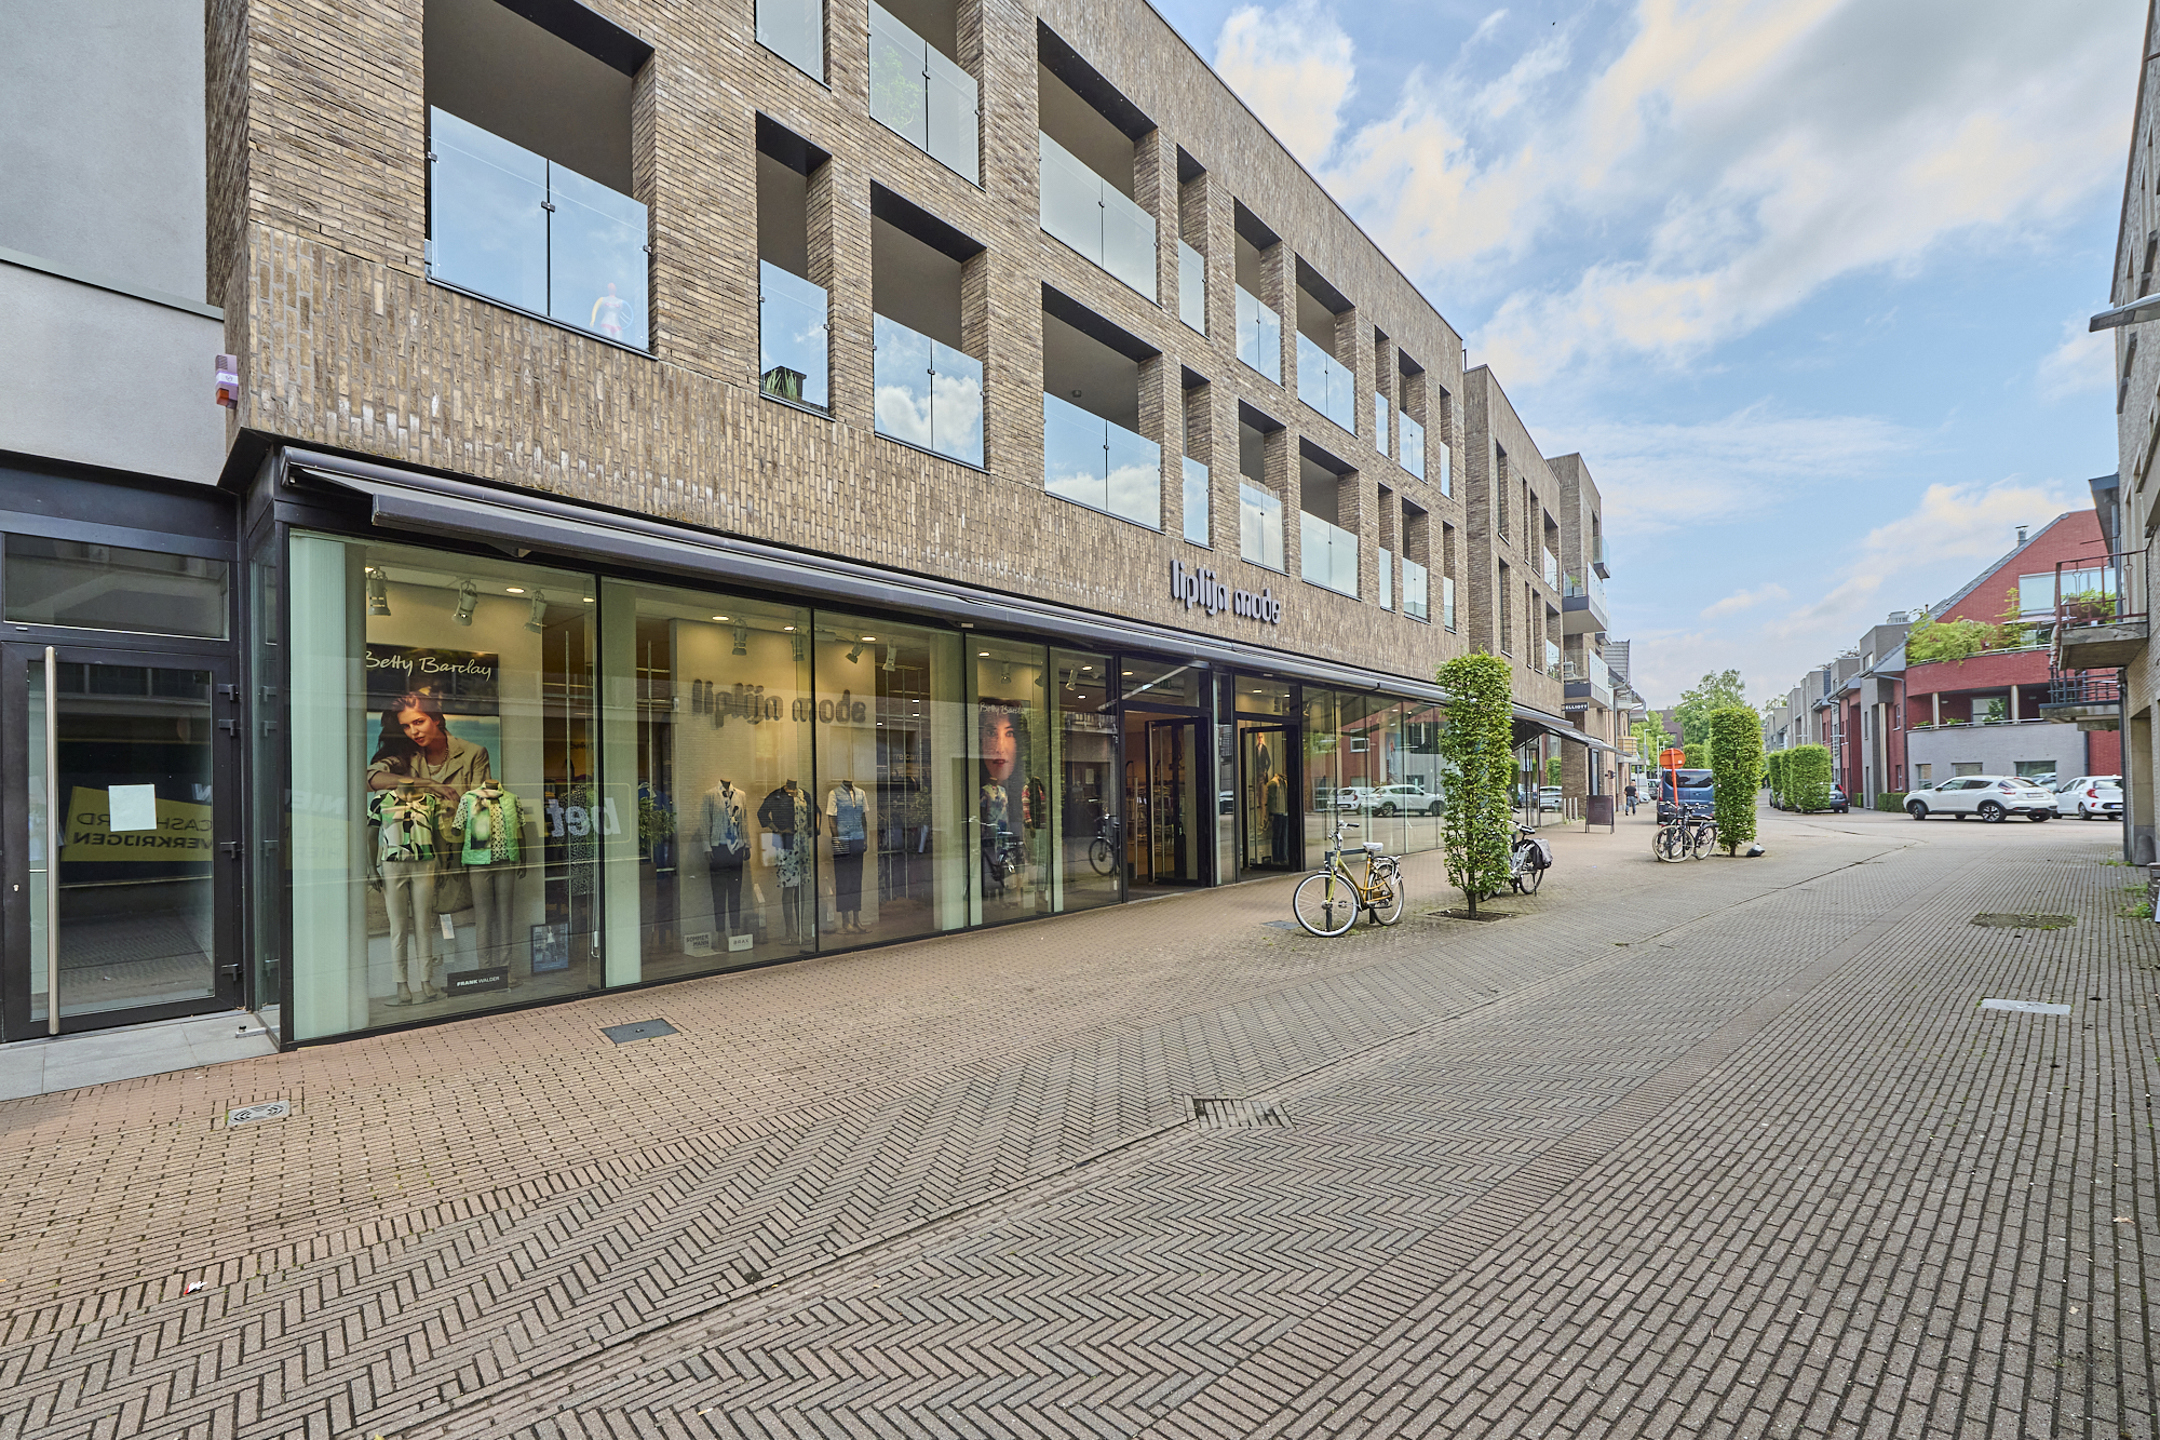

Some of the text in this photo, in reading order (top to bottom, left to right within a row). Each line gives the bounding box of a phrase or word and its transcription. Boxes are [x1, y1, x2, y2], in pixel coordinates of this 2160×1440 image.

[1170, 558, 1281, 625] liplijn mode
[366, 650, 491, 682] Betty Barclay
[692, 679, 867, 729] liplijn mode
[456, 979, 478, 987] FRANK
